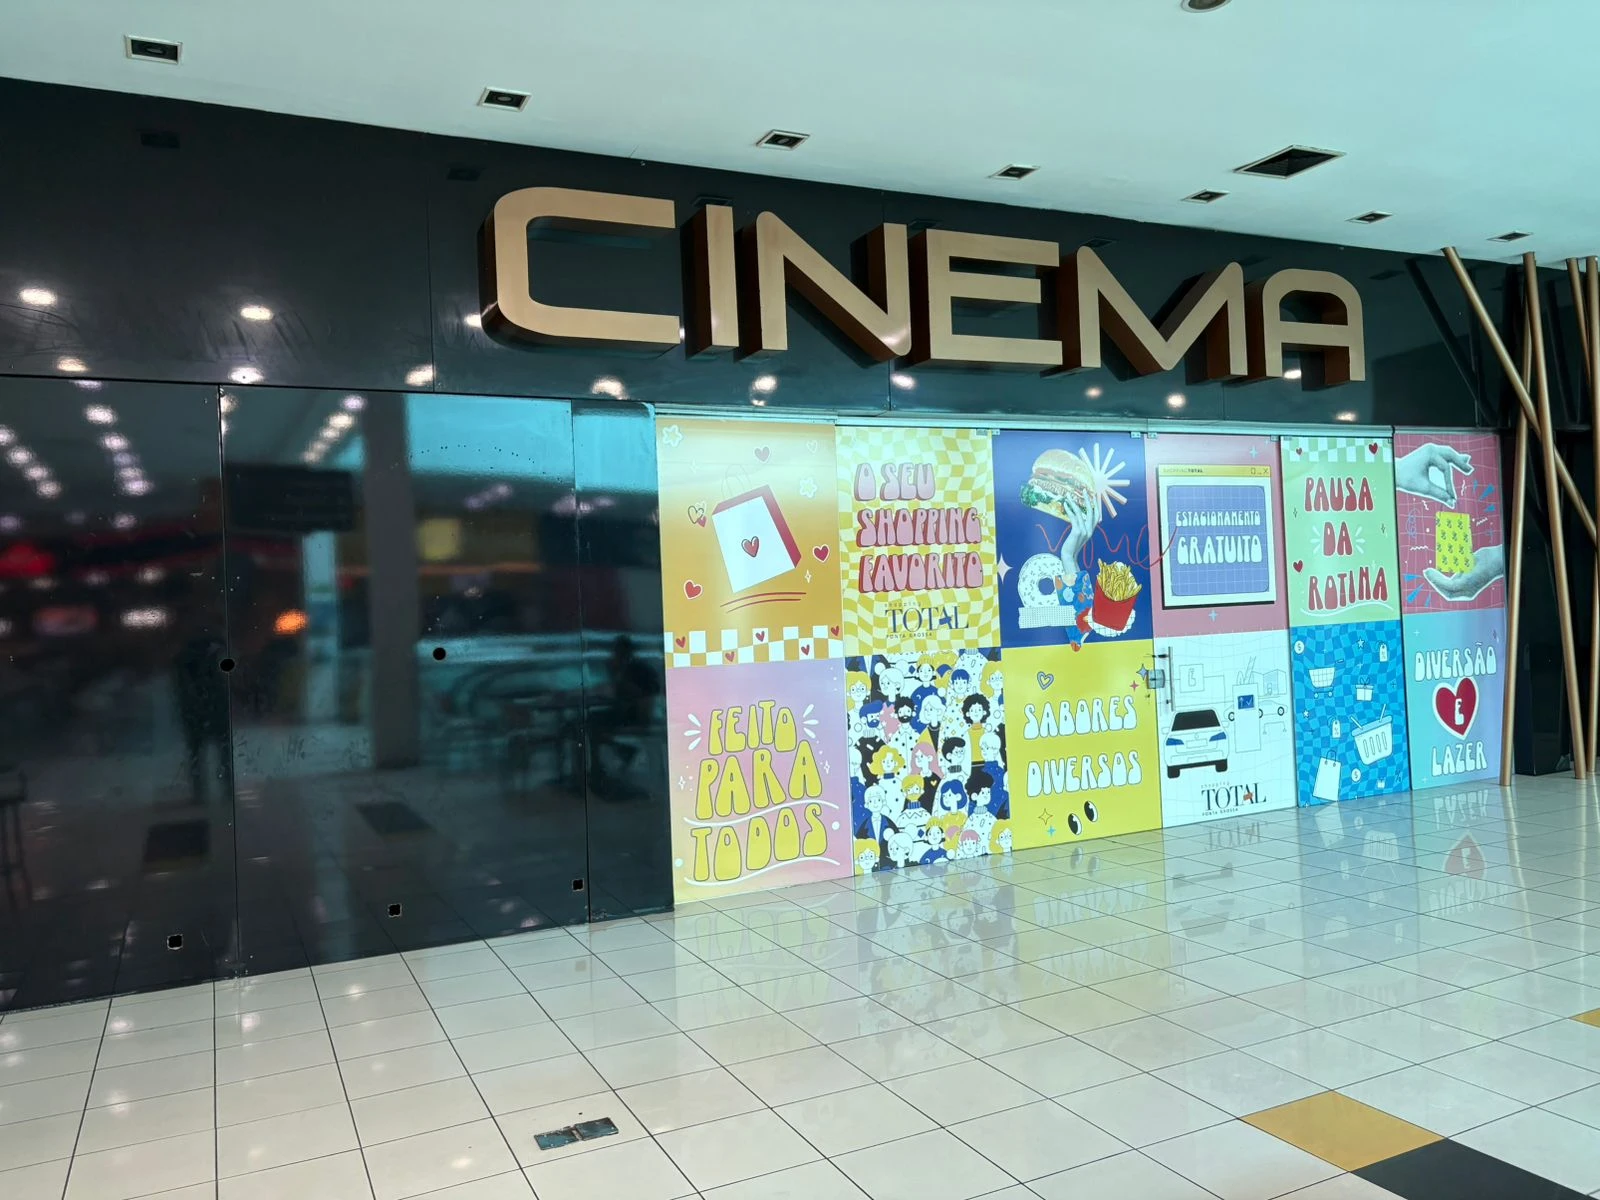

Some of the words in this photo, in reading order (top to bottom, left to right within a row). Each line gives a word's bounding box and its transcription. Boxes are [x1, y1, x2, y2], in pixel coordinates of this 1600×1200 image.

[488, 185, 1366, 382] CINEMA
[854, 463, 876, 501] O
[880, 463, 936, 501] SEU
[1304, 476, 1374, 512] PAUSA
[856, 507, 983, 548] SHOPPING
[1175, 510, 1261, 527] ESTACIONAMENTO
[1323, 521, 1353, 557] DA
[1177, 535, 1262, 565] GRATUITO
[859, 551, 984, 593] FAVORITO
[1308, 566, 1388, 611] ROTINA
[884, 605, 969, 633] TOTAL
[1414, 641, 1497, 682] DIVERSÃO
[708, 700, 797, 756] FEITO
[1023, 694, 1138, 741] SABORES
[1454, 698, 1465, 726] E
[1026, 749, 1143, 798] DIVERSOS
[1431, 741, 1488, 777] LAZER
[695, 740, 822, 820] PARA
[1201, 783, 1266, 811] TOTAL
[691, 803, 828, 882] TODOS
